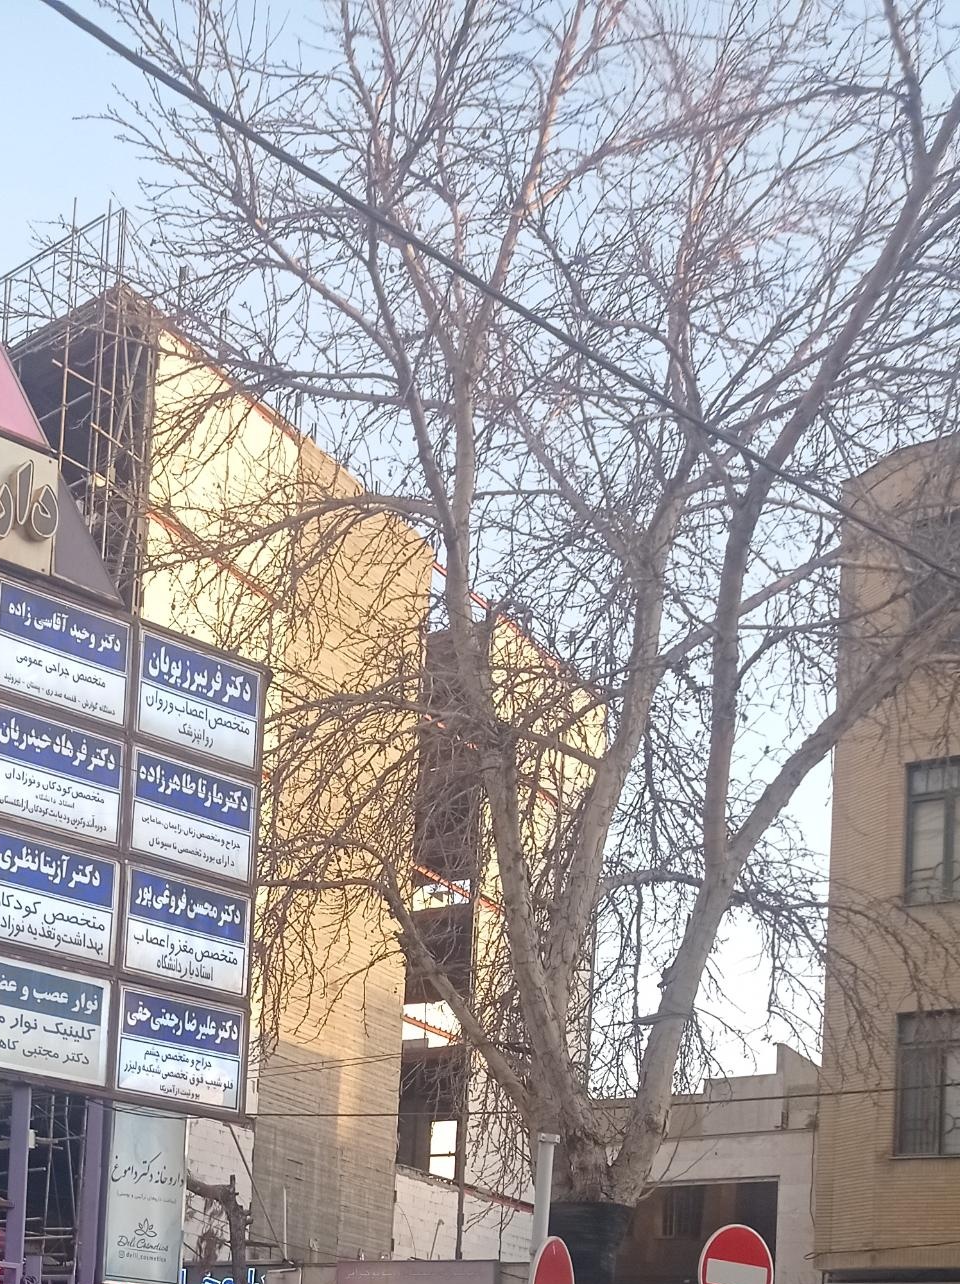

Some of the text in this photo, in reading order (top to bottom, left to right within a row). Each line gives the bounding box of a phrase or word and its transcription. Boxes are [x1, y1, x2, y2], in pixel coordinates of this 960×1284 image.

[16, 654, 105, 688] متخصص جراحی عمومی
[149, 647, 251, 702] دکتر فریبرز پویان
[0, 717, 115, 771] دکتر فرهاد حیدریان
[179, 723, 214, 748] روانپزشک
[40, 851, 70, 884] آزیتا
[68, 865, 100, 888] دکتر
[28, 921, 55, 940] تغذیه
[44, 912, 104, 931] متخصص
[55, 936, 60, 948] و
[62, 932, 103, 955] بهداشت
[134, 929, 238, 965] متخصص مغز و اعصاب
[157, 955, 213, 980] استادیار دانشگاه
[20, 986, 29, 1000] و
[33, 988, 68, 1003] عصب
[71, 993, 98, 1014] نوار
[10, 1014, 37, 1034] نوار
[43, 1022, 95, 1042] کلینیک
[23, 1046, 59, 1060] مجتبی
[62, 1053, 89, 1064] دکتر
